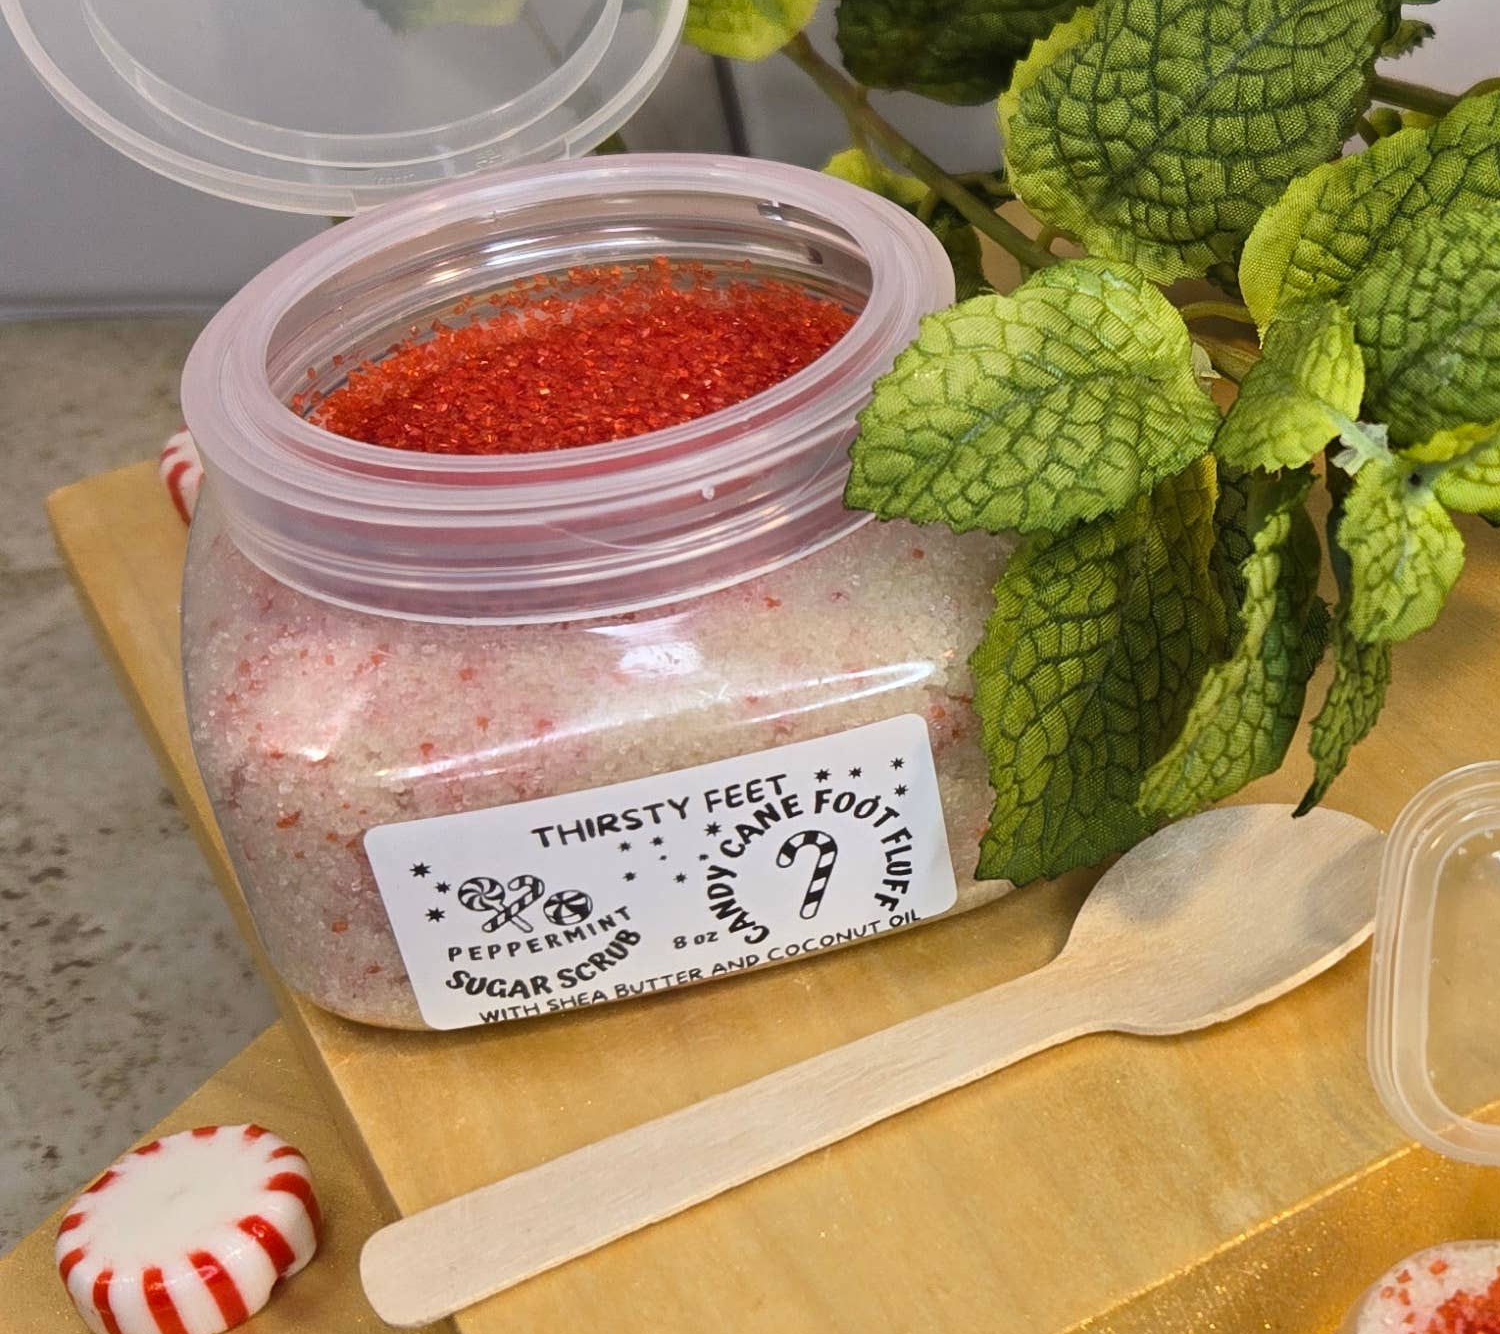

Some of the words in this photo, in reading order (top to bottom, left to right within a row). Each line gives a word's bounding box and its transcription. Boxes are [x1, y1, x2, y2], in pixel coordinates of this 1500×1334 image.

[531, 796, 690, 848] THIRSTY
[703, 774, 787, 814] FEET
[720, 794, 804, 858] CANE
[814, 789, 900, 828] FOOT
[707, 865, 770, 945] CANDY
[874, 827, 913, 912] FLUFF
[446, 970, 553, 999] SUGAR
[557, 928, 641, 989] SCRUB
[448, 905, 632, 962] PEPPERMINT
[479, 1002, 541, 1023] WITH
[547, 989, 609, 1013] SHEA
[614, 968, 702, 998] BUTTER
[711, 954, 760, 976] AND
[767, 920, 882, 961] COCONUT
[889, 909, 922, 928] OIL
[673, 935, 688, 950] 8
[694, 931, 719, 946] oz
